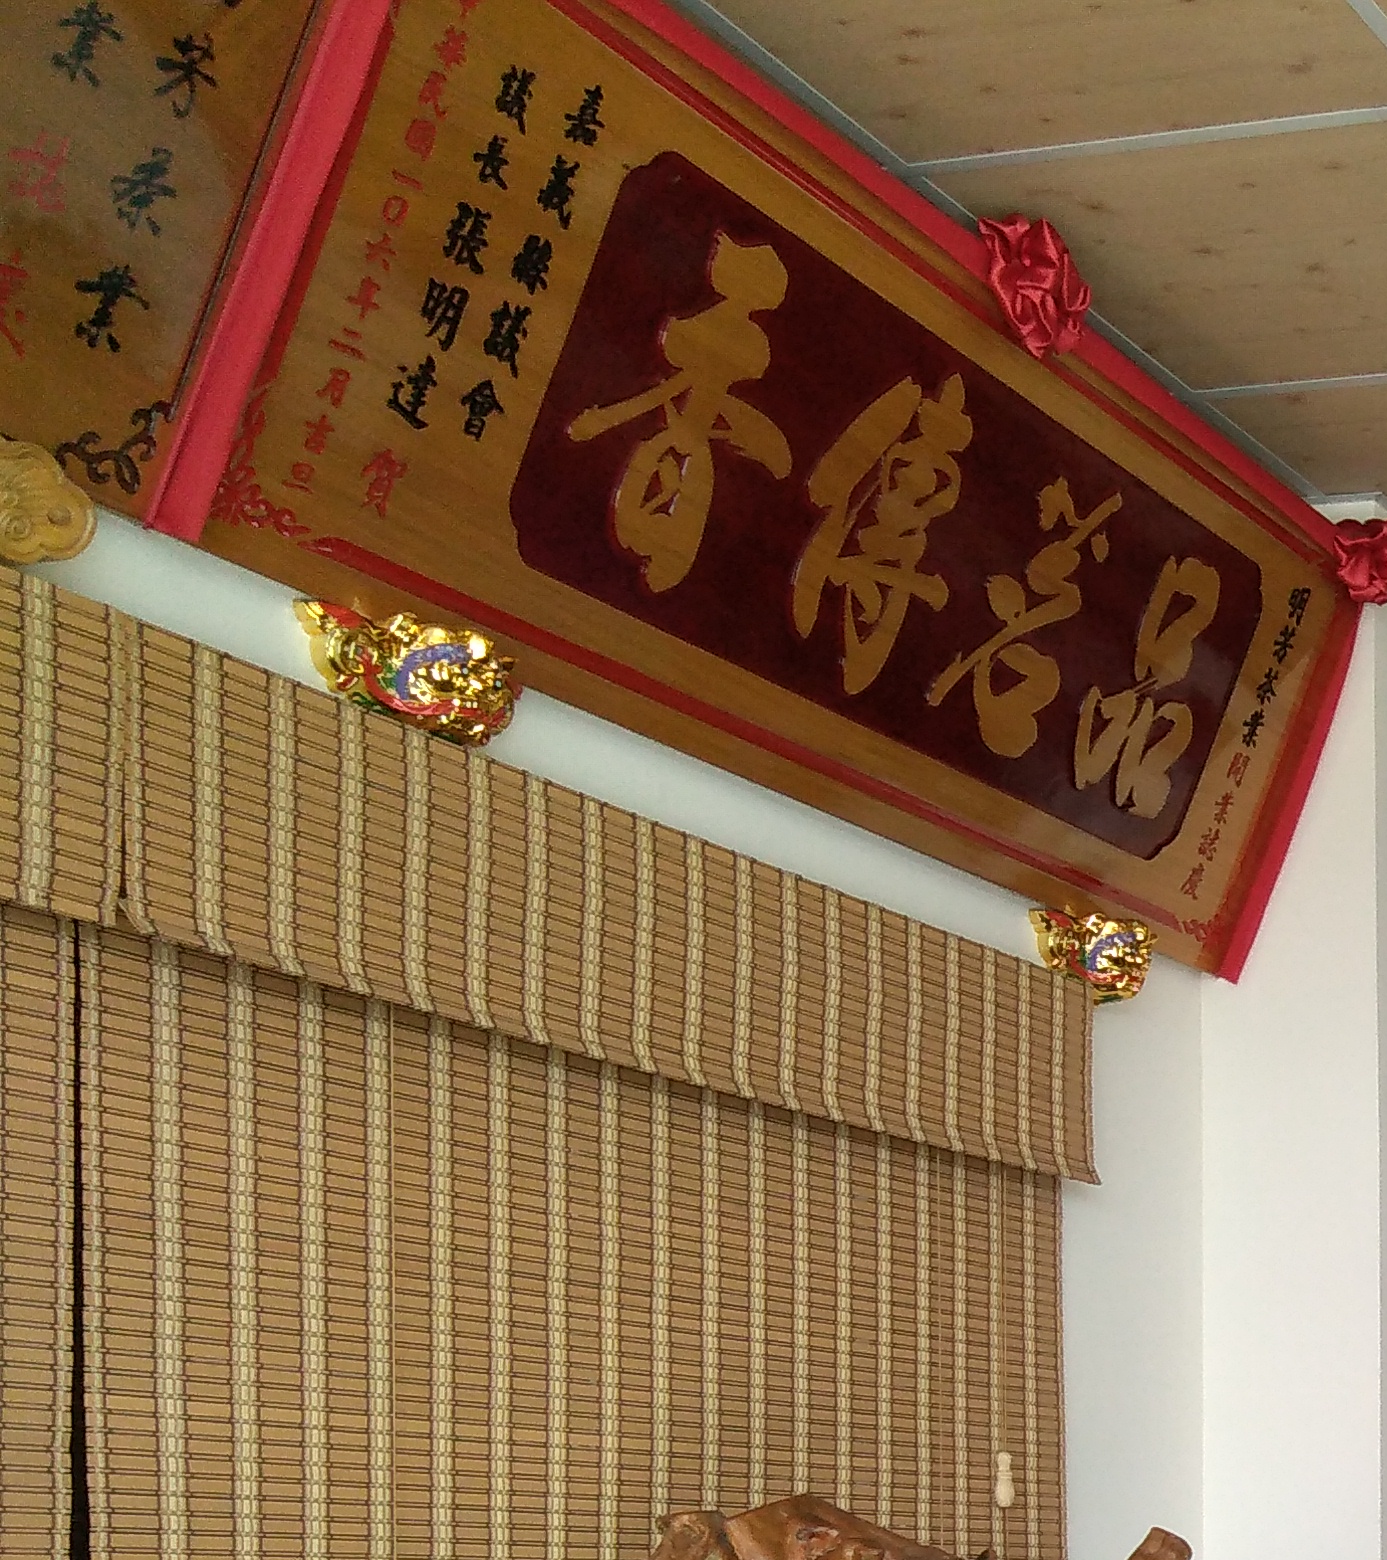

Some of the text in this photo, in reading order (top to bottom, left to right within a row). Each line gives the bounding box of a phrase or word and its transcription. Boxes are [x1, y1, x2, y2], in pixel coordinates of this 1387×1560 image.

[74, 0, 241, 353] 芳茶業
[460, 84, 605, 442] 嘉義縣議會
